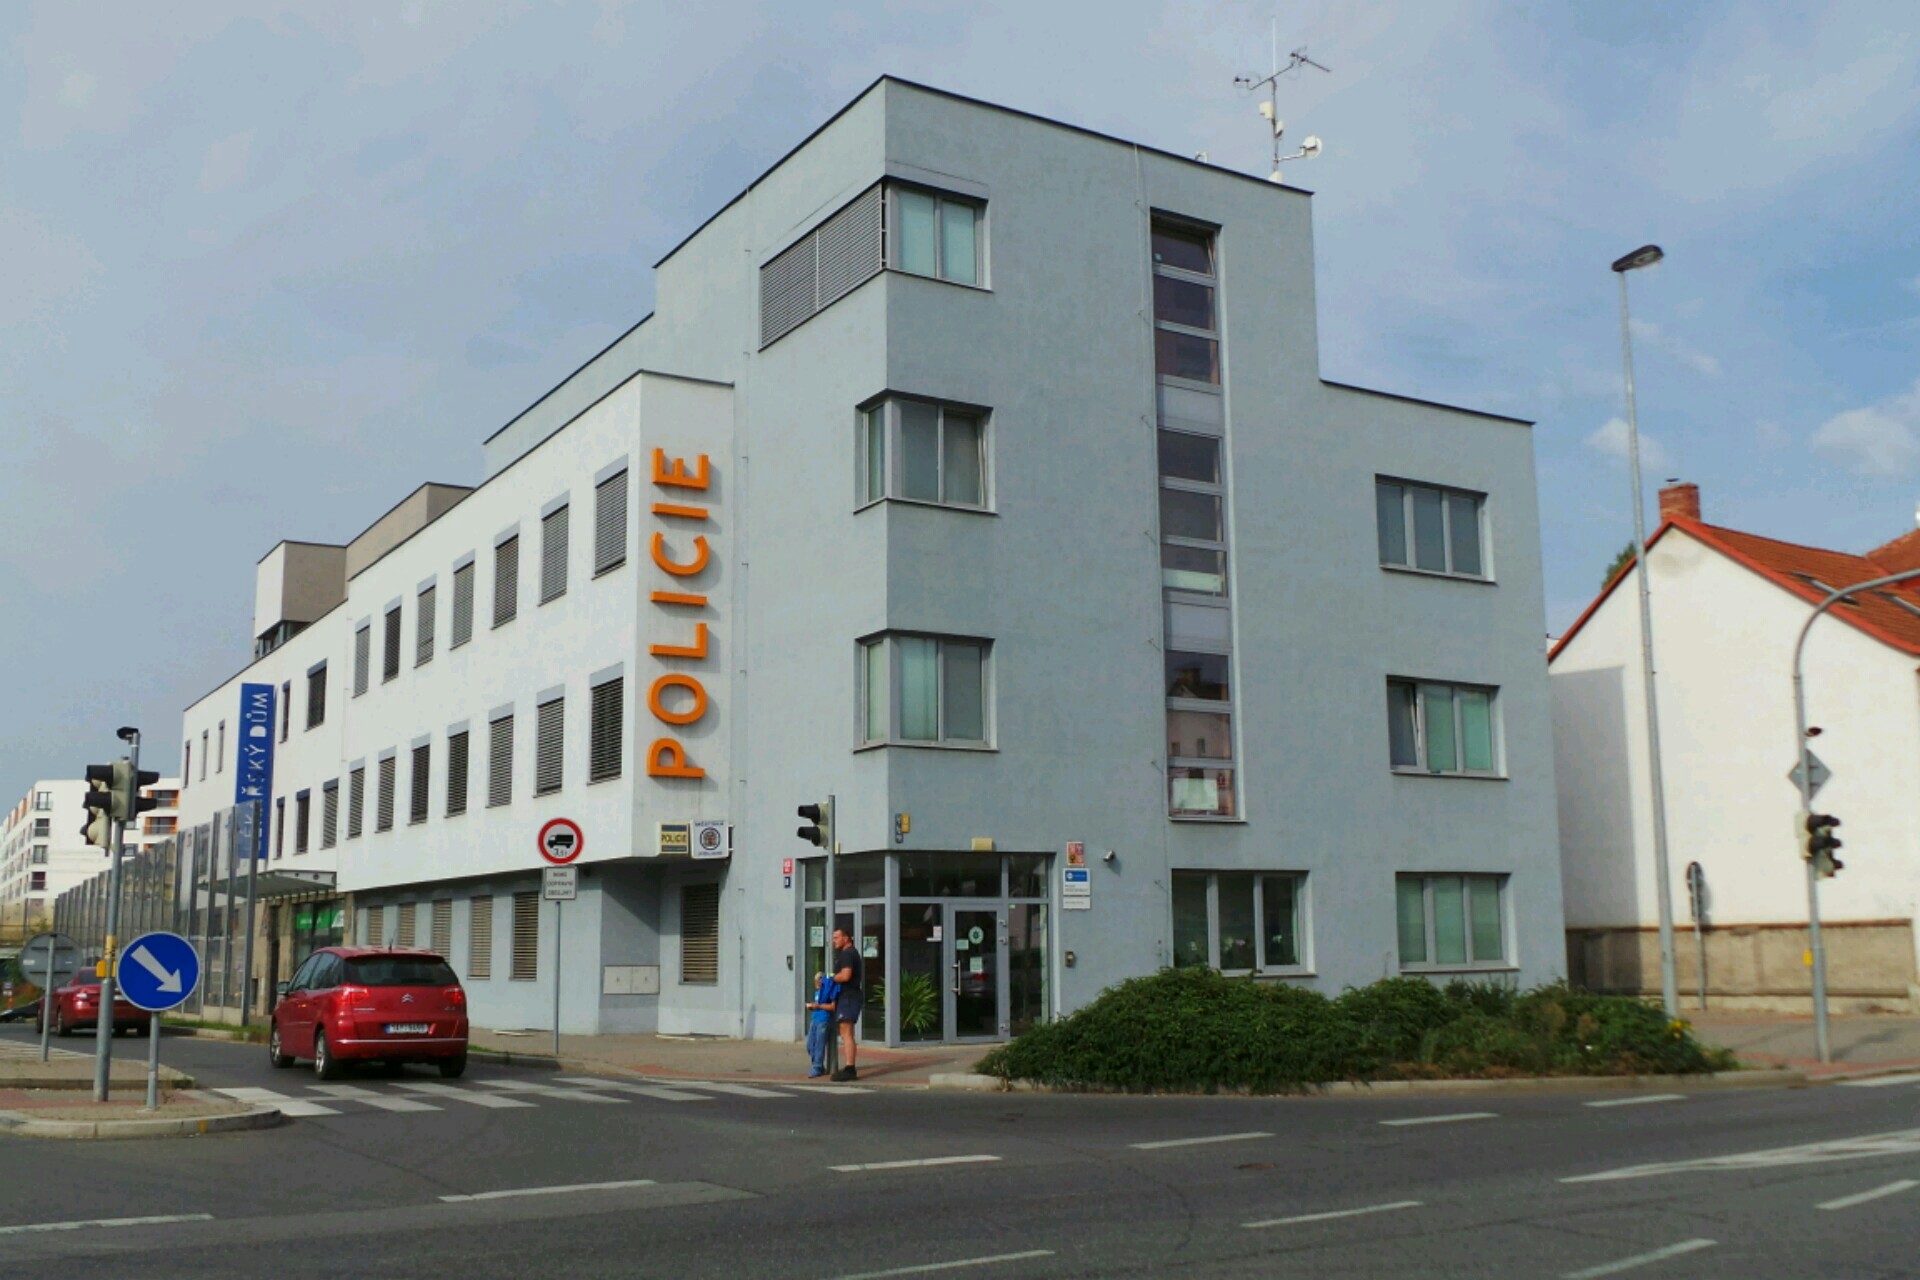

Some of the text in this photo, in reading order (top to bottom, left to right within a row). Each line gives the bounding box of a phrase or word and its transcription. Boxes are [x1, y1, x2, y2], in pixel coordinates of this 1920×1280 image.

[647, 447, 711, 779] POLICIE
[245, 692, 269, 738] DŮM
[661, 833, 687, 844] POLICIE
